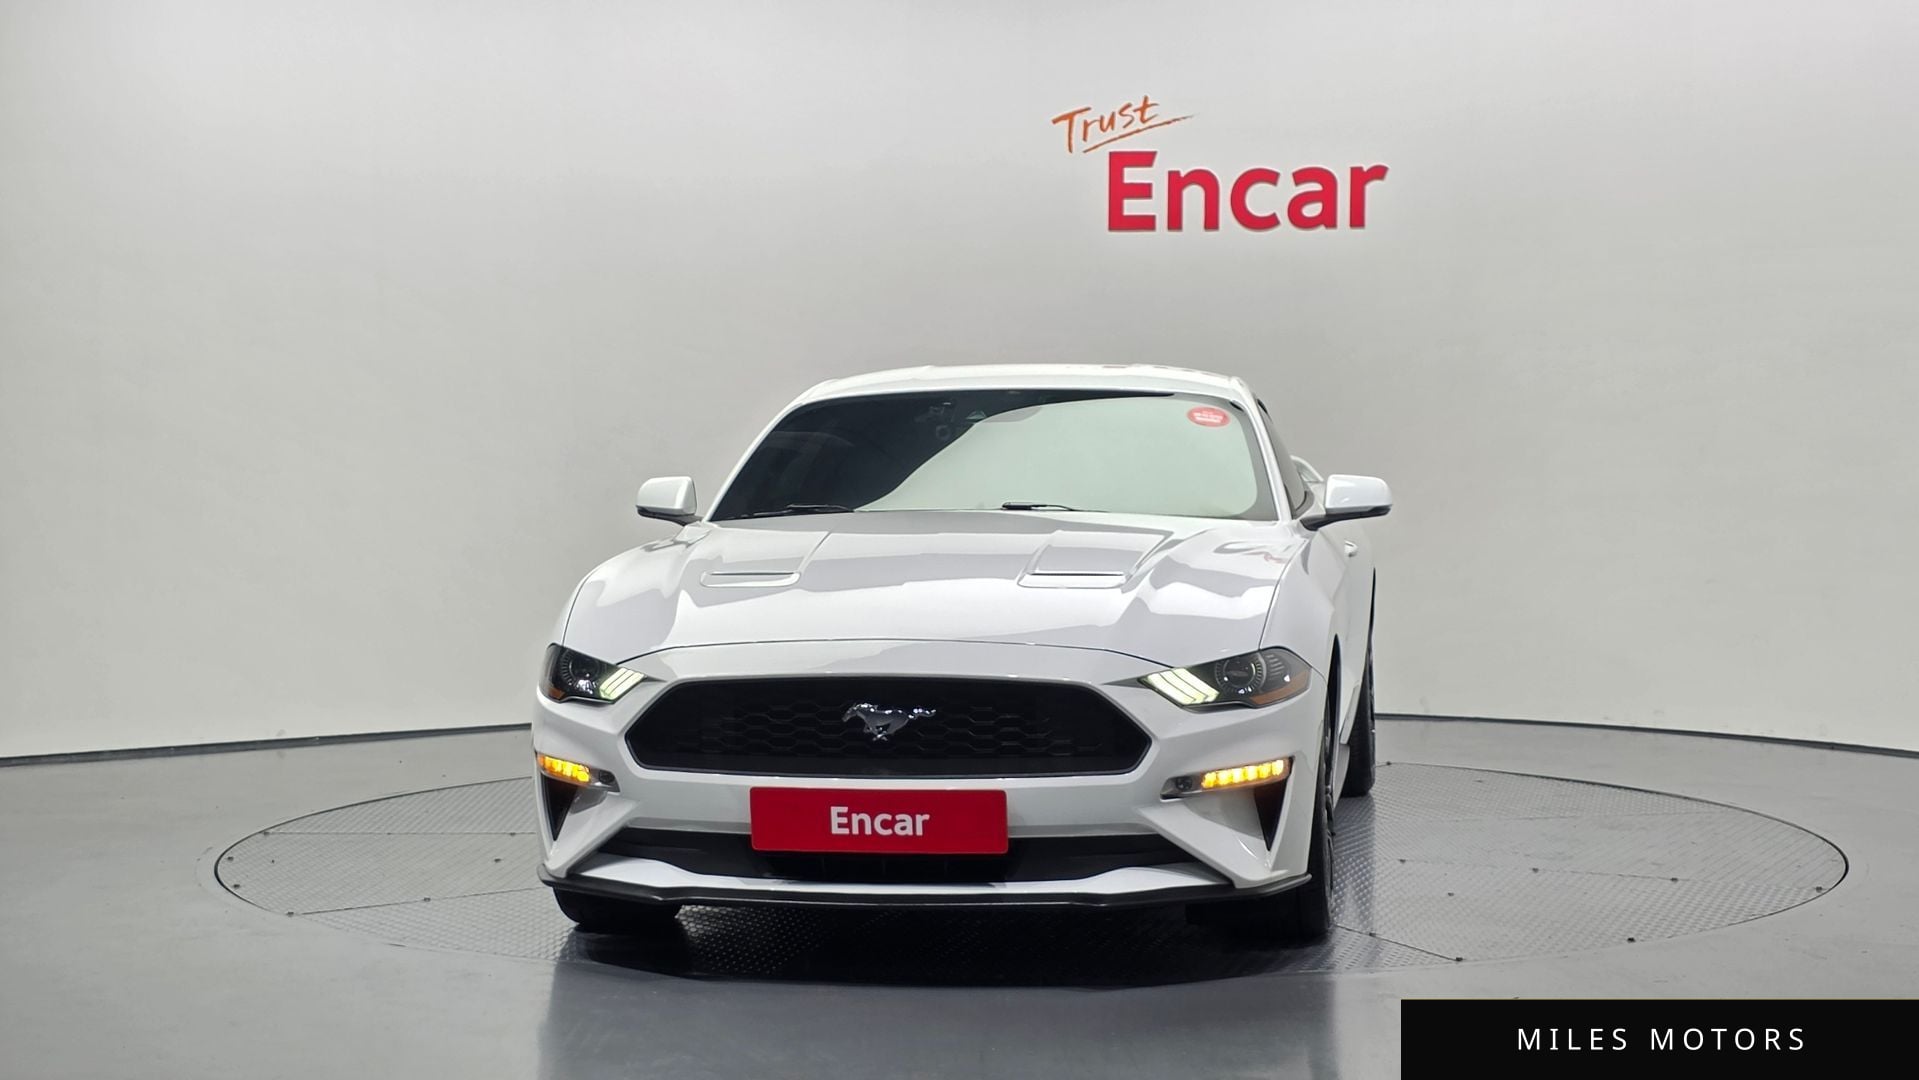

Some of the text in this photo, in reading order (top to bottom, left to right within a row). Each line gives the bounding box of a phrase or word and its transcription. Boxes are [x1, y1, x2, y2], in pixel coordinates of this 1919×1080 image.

[1052, 95, 1161, 153] Trust
[1108, 151, 1389, 231] Encar
[829, 806, 930, 836] Encar
